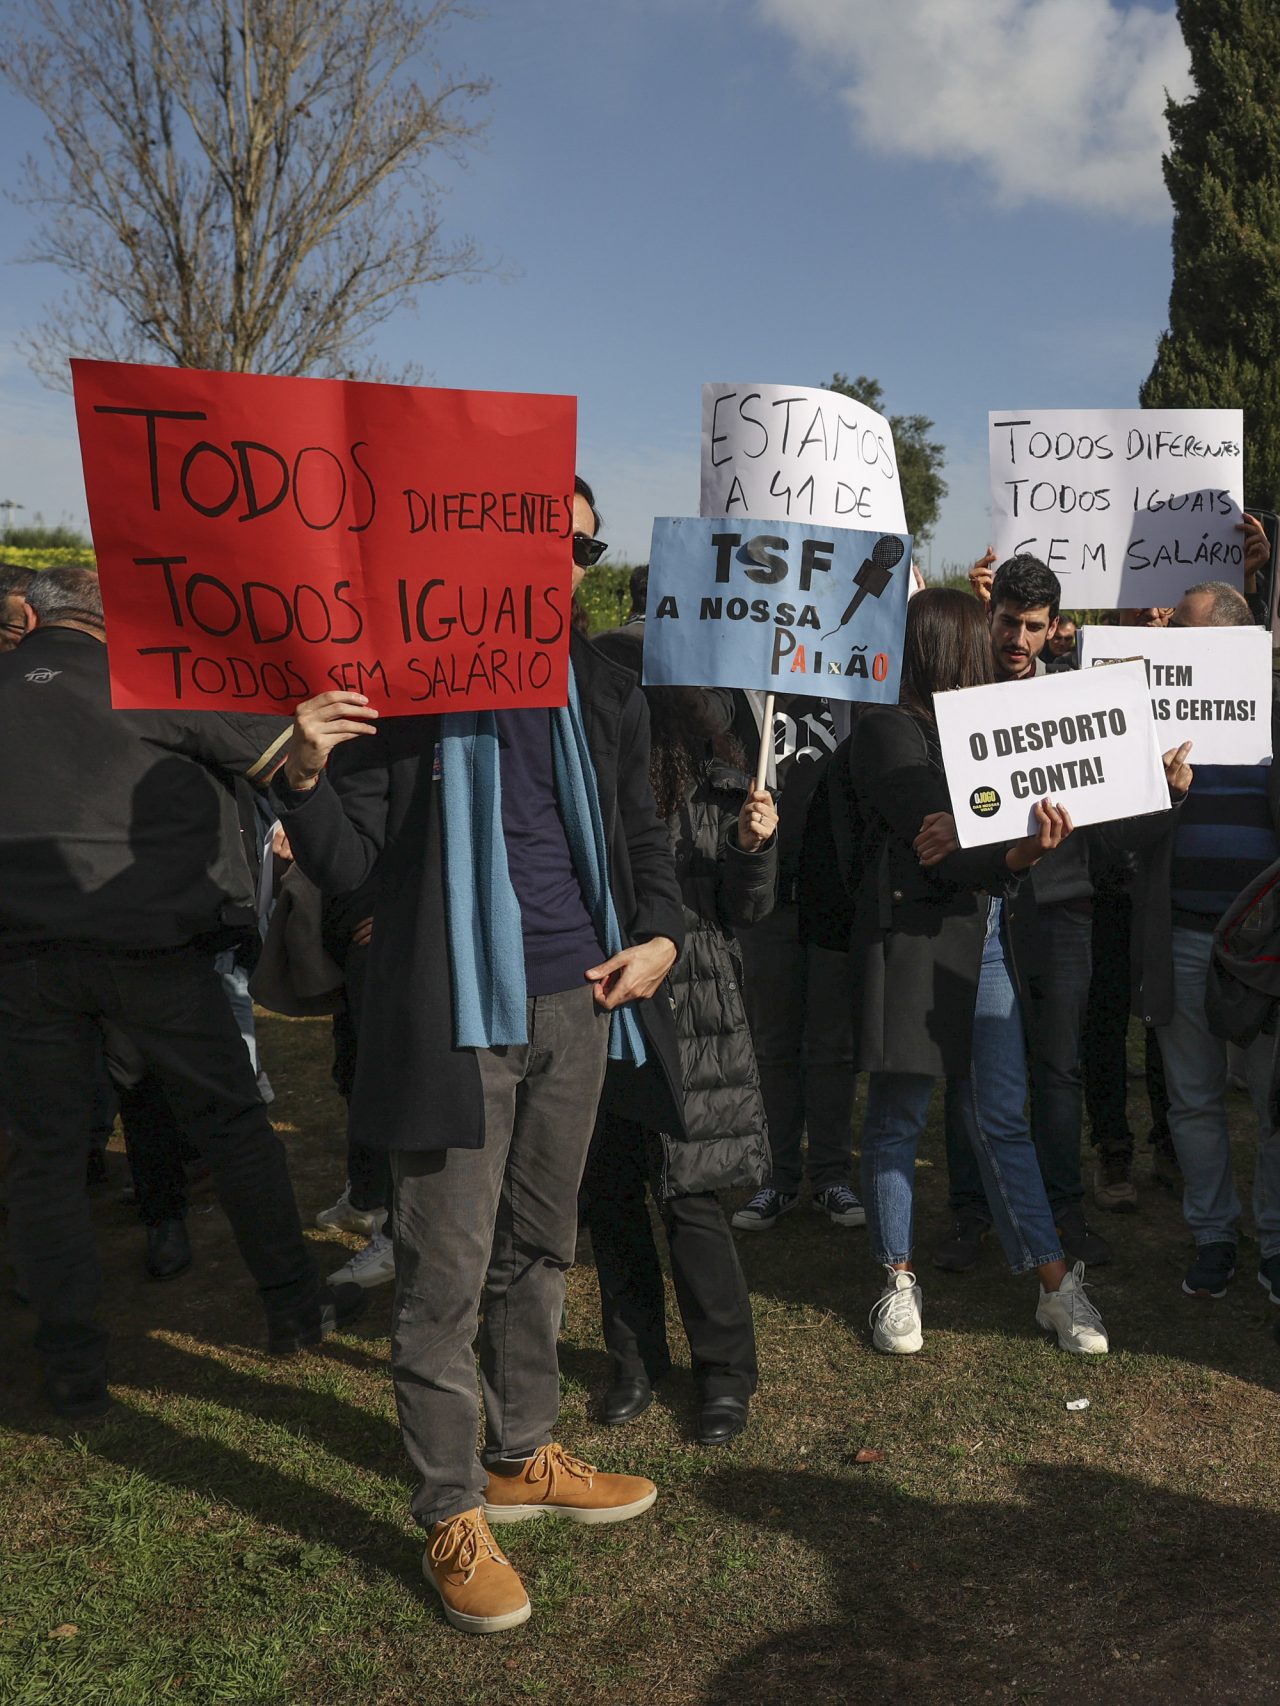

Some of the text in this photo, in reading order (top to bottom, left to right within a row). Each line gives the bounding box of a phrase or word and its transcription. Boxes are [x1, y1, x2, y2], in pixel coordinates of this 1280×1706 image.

[710, 392, 894, 479] ESTAMOS
[994, 420, 1240, 464] TODOS DIFERENTES
[93, 405, 573, 539] TODOS DIFERENTES
[725, 470, 872, 518] A 41 DE
[1004, 479, 1232, 517] TODOS IGUAIS
[711, 533, 835, 591] TSF
[1127, 532, 1243, 570] SALÁRIO
[132, 556, 562, 644] TODOS IGUAIS
[656, 596, 822, 630] A NOSSA
[137, 642, 552, 700] TODOS SEM SALÁRIO
[771, 626, 889, 683] PAIXÃO
[1153, 665, 1193, 687] TEM
[1175, 699, 1257, 721] CERTAS!
[968, 708, 1127, 761] O DESPORTO
[1010, 756, 1105, 799] CONTA!
